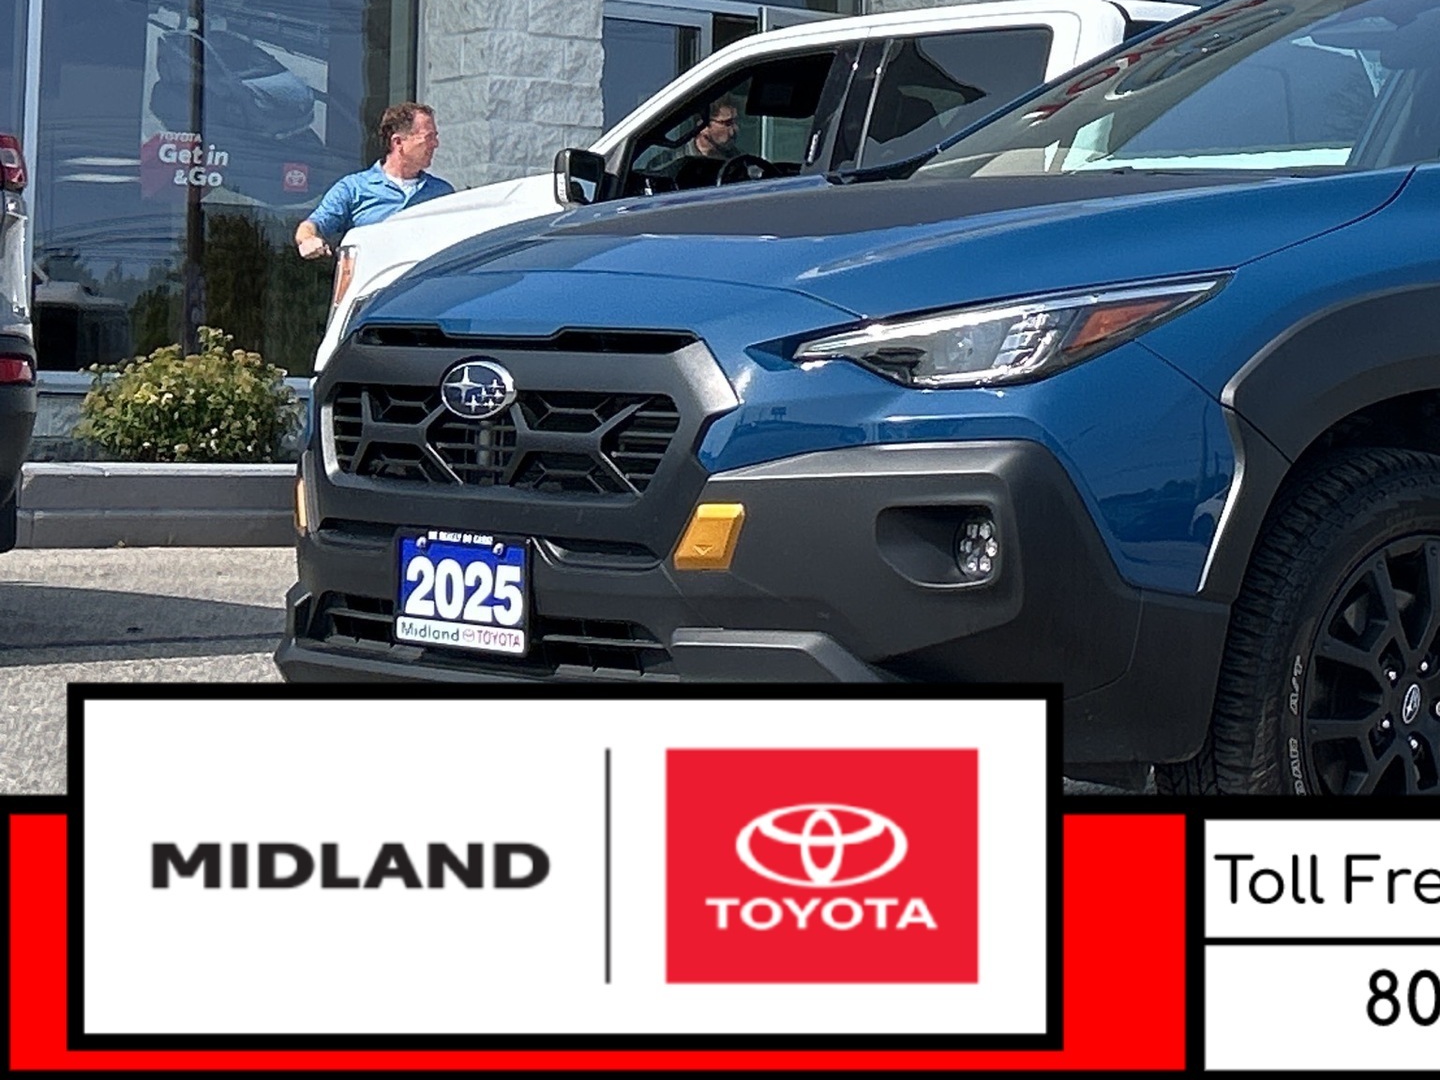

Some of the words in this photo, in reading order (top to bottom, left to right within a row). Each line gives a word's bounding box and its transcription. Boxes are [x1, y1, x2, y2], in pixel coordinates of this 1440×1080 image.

[158, 143, 203, 165] Get
[206, 144, 229, 167] in
[404, 555, 523, 626] 2025
[401, 621, 460, 642] Midland
[477, 629, 520, 647] TOYOTA
